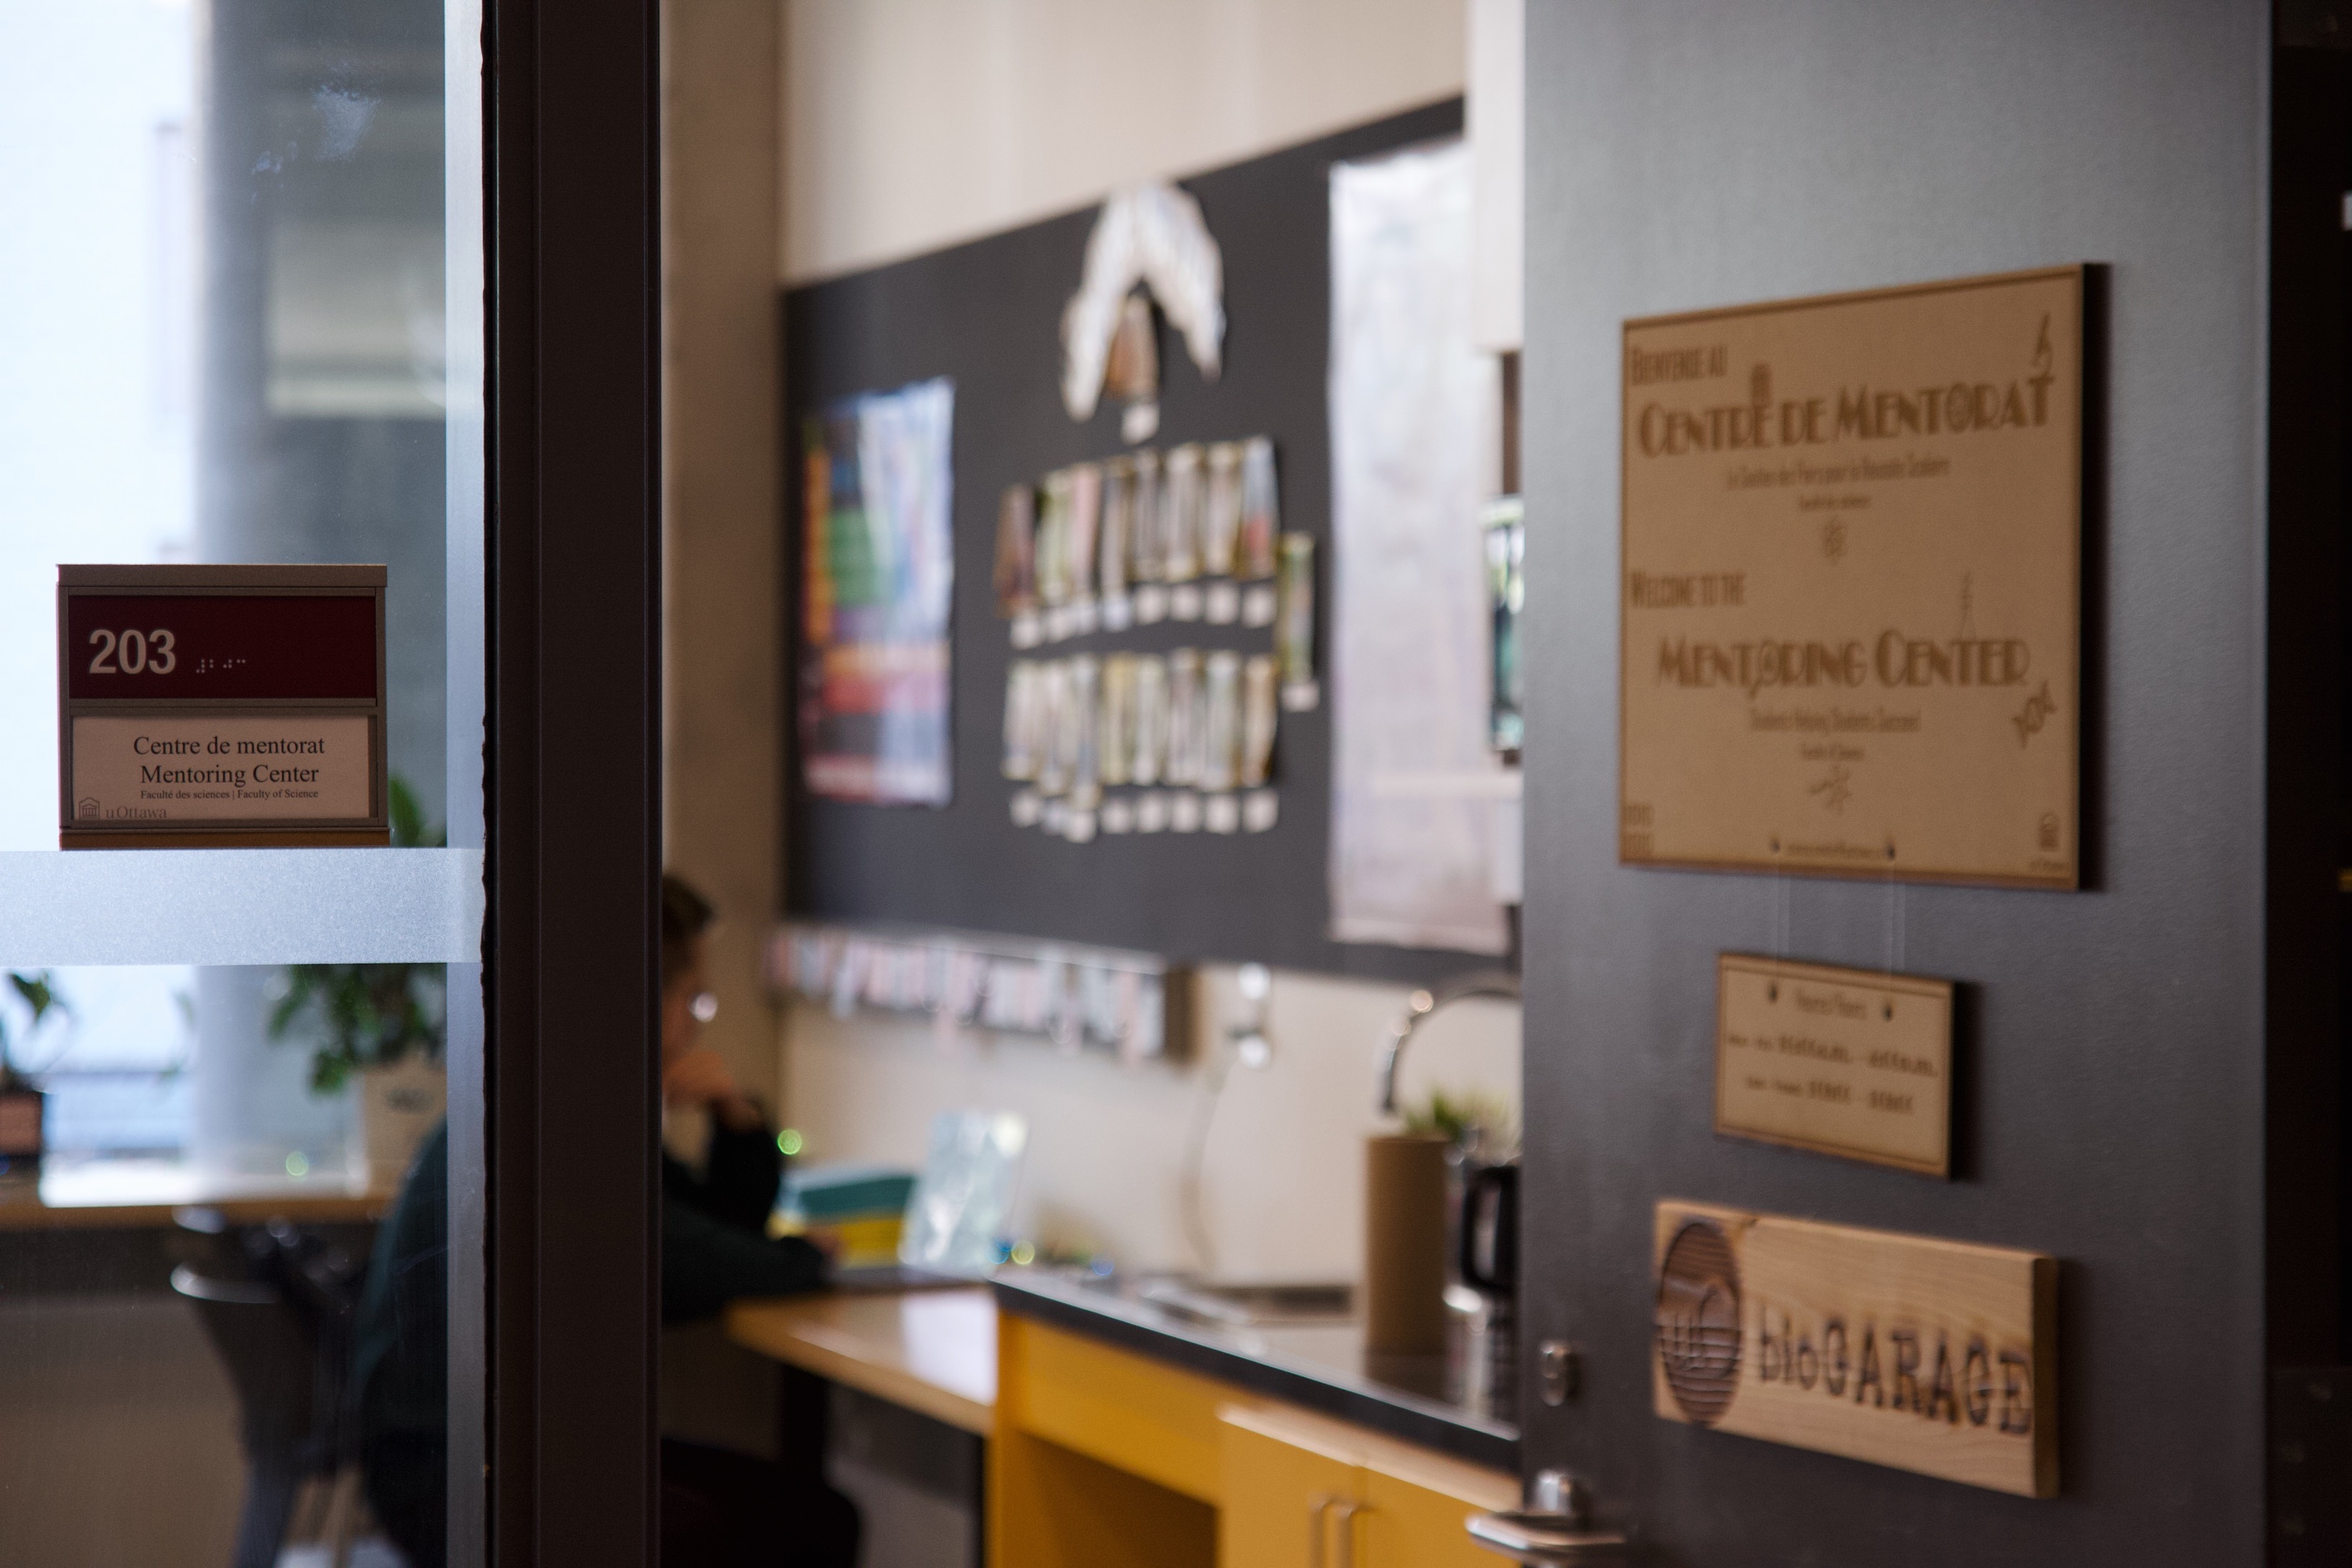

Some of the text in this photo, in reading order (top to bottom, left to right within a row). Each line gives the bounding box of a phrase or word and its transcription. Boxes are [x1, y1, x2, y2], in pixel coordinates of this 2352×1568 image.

[1780, 396, 1828, 447] DE
[1835, 374, 2055, 441] MENTORAT
[89, 628, 177, 674] 203
[1657, 628, 2031, 689] MENTORING CENTER
[133, 736, 326, 754] Centre de mentorat
[141, 765, 319, 788] Mentoring Center
[141, 790, 174, 799] Faculté
[175, 790, 191, 799] des
[193, 790, 230, 799] sciences
[237, 790, 270, 801] Faculty
[272, 790, 283, 799] of
[285, 789, 319, 798] Science
